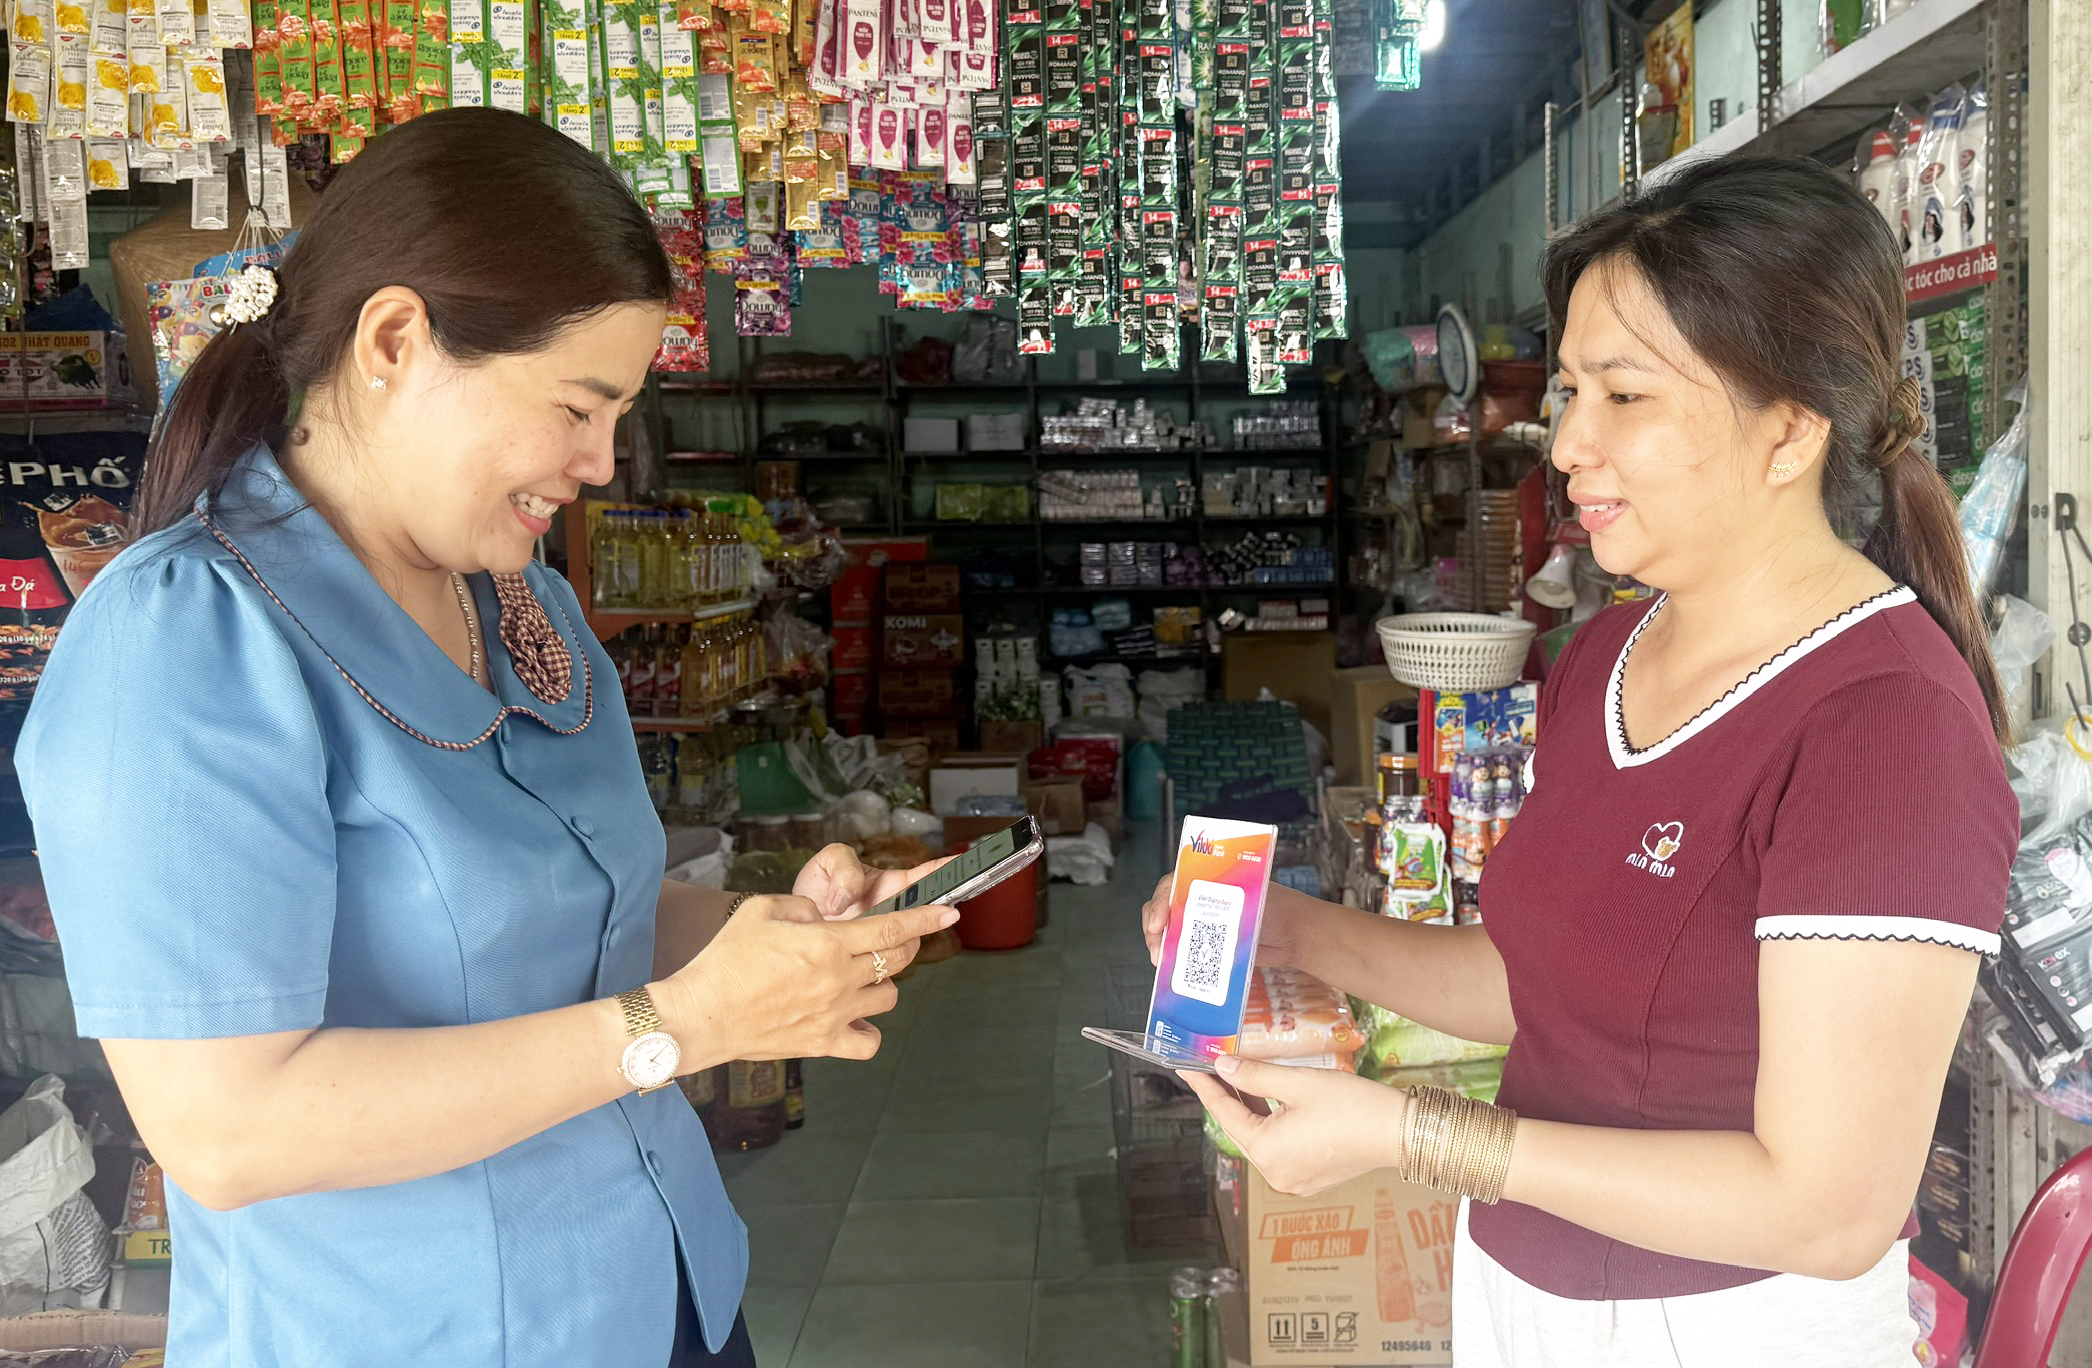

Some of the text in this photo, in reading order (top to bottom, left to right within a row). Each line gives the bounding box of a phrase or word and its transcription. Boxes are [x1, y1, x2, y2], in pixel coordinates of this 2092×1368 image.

[747, 243, 783, 258] owny
[1916, 270, 1933, 288] tóc
[1934, 264, 1955, 284] cho
[1957, 257, 1971, 279] cả
[1973, 251, 1997, 275] nhà
[54, 335, 90, 346] QUANG
[662, 337, 698, 350] owny
[11, 576, 35, 591] Đá
[886, 617, 926, 629] KOMI
[1190, 829, 1213, 855] Vikki
[1311, 1317, 1319, 1331] 5
